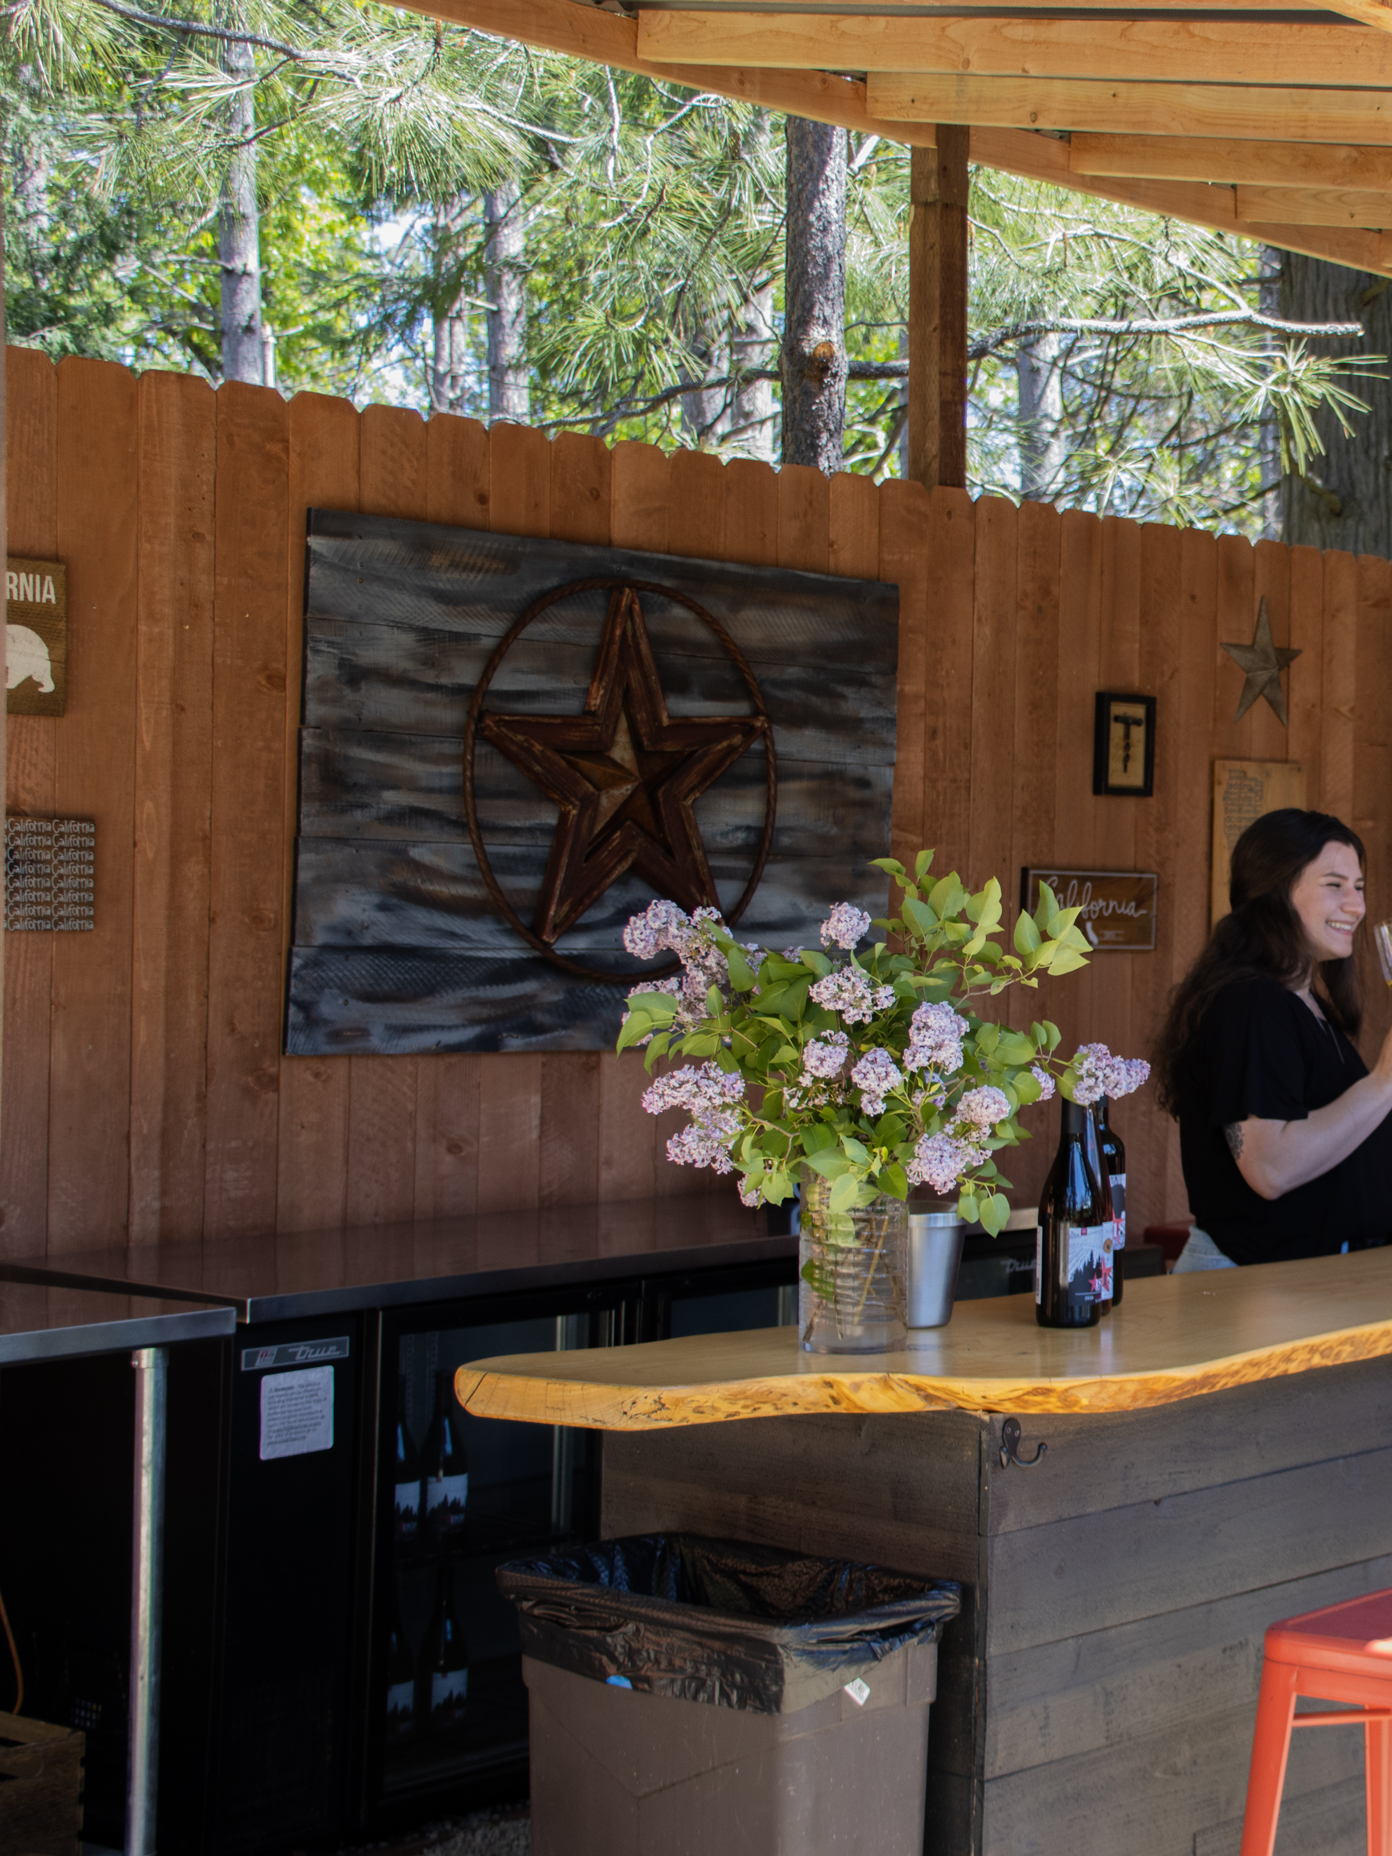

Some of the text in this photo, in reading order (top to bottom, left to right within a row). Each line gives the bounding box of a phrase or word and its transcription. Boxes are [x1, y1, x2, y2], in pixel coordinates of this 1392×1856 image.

[7, 571, 56, 604] RNIA
[8, 818, 95, 833] California California
[8, 833, 95, 848] California California
[7, 847, 94, 861] California California
[7, 860, 94, 875] California California
[7, 874, 94, 889] California California
[7, 888, 94, 903] California California
[7, 902, 94, 917] California California
[7, 917, 94, 931] California California
